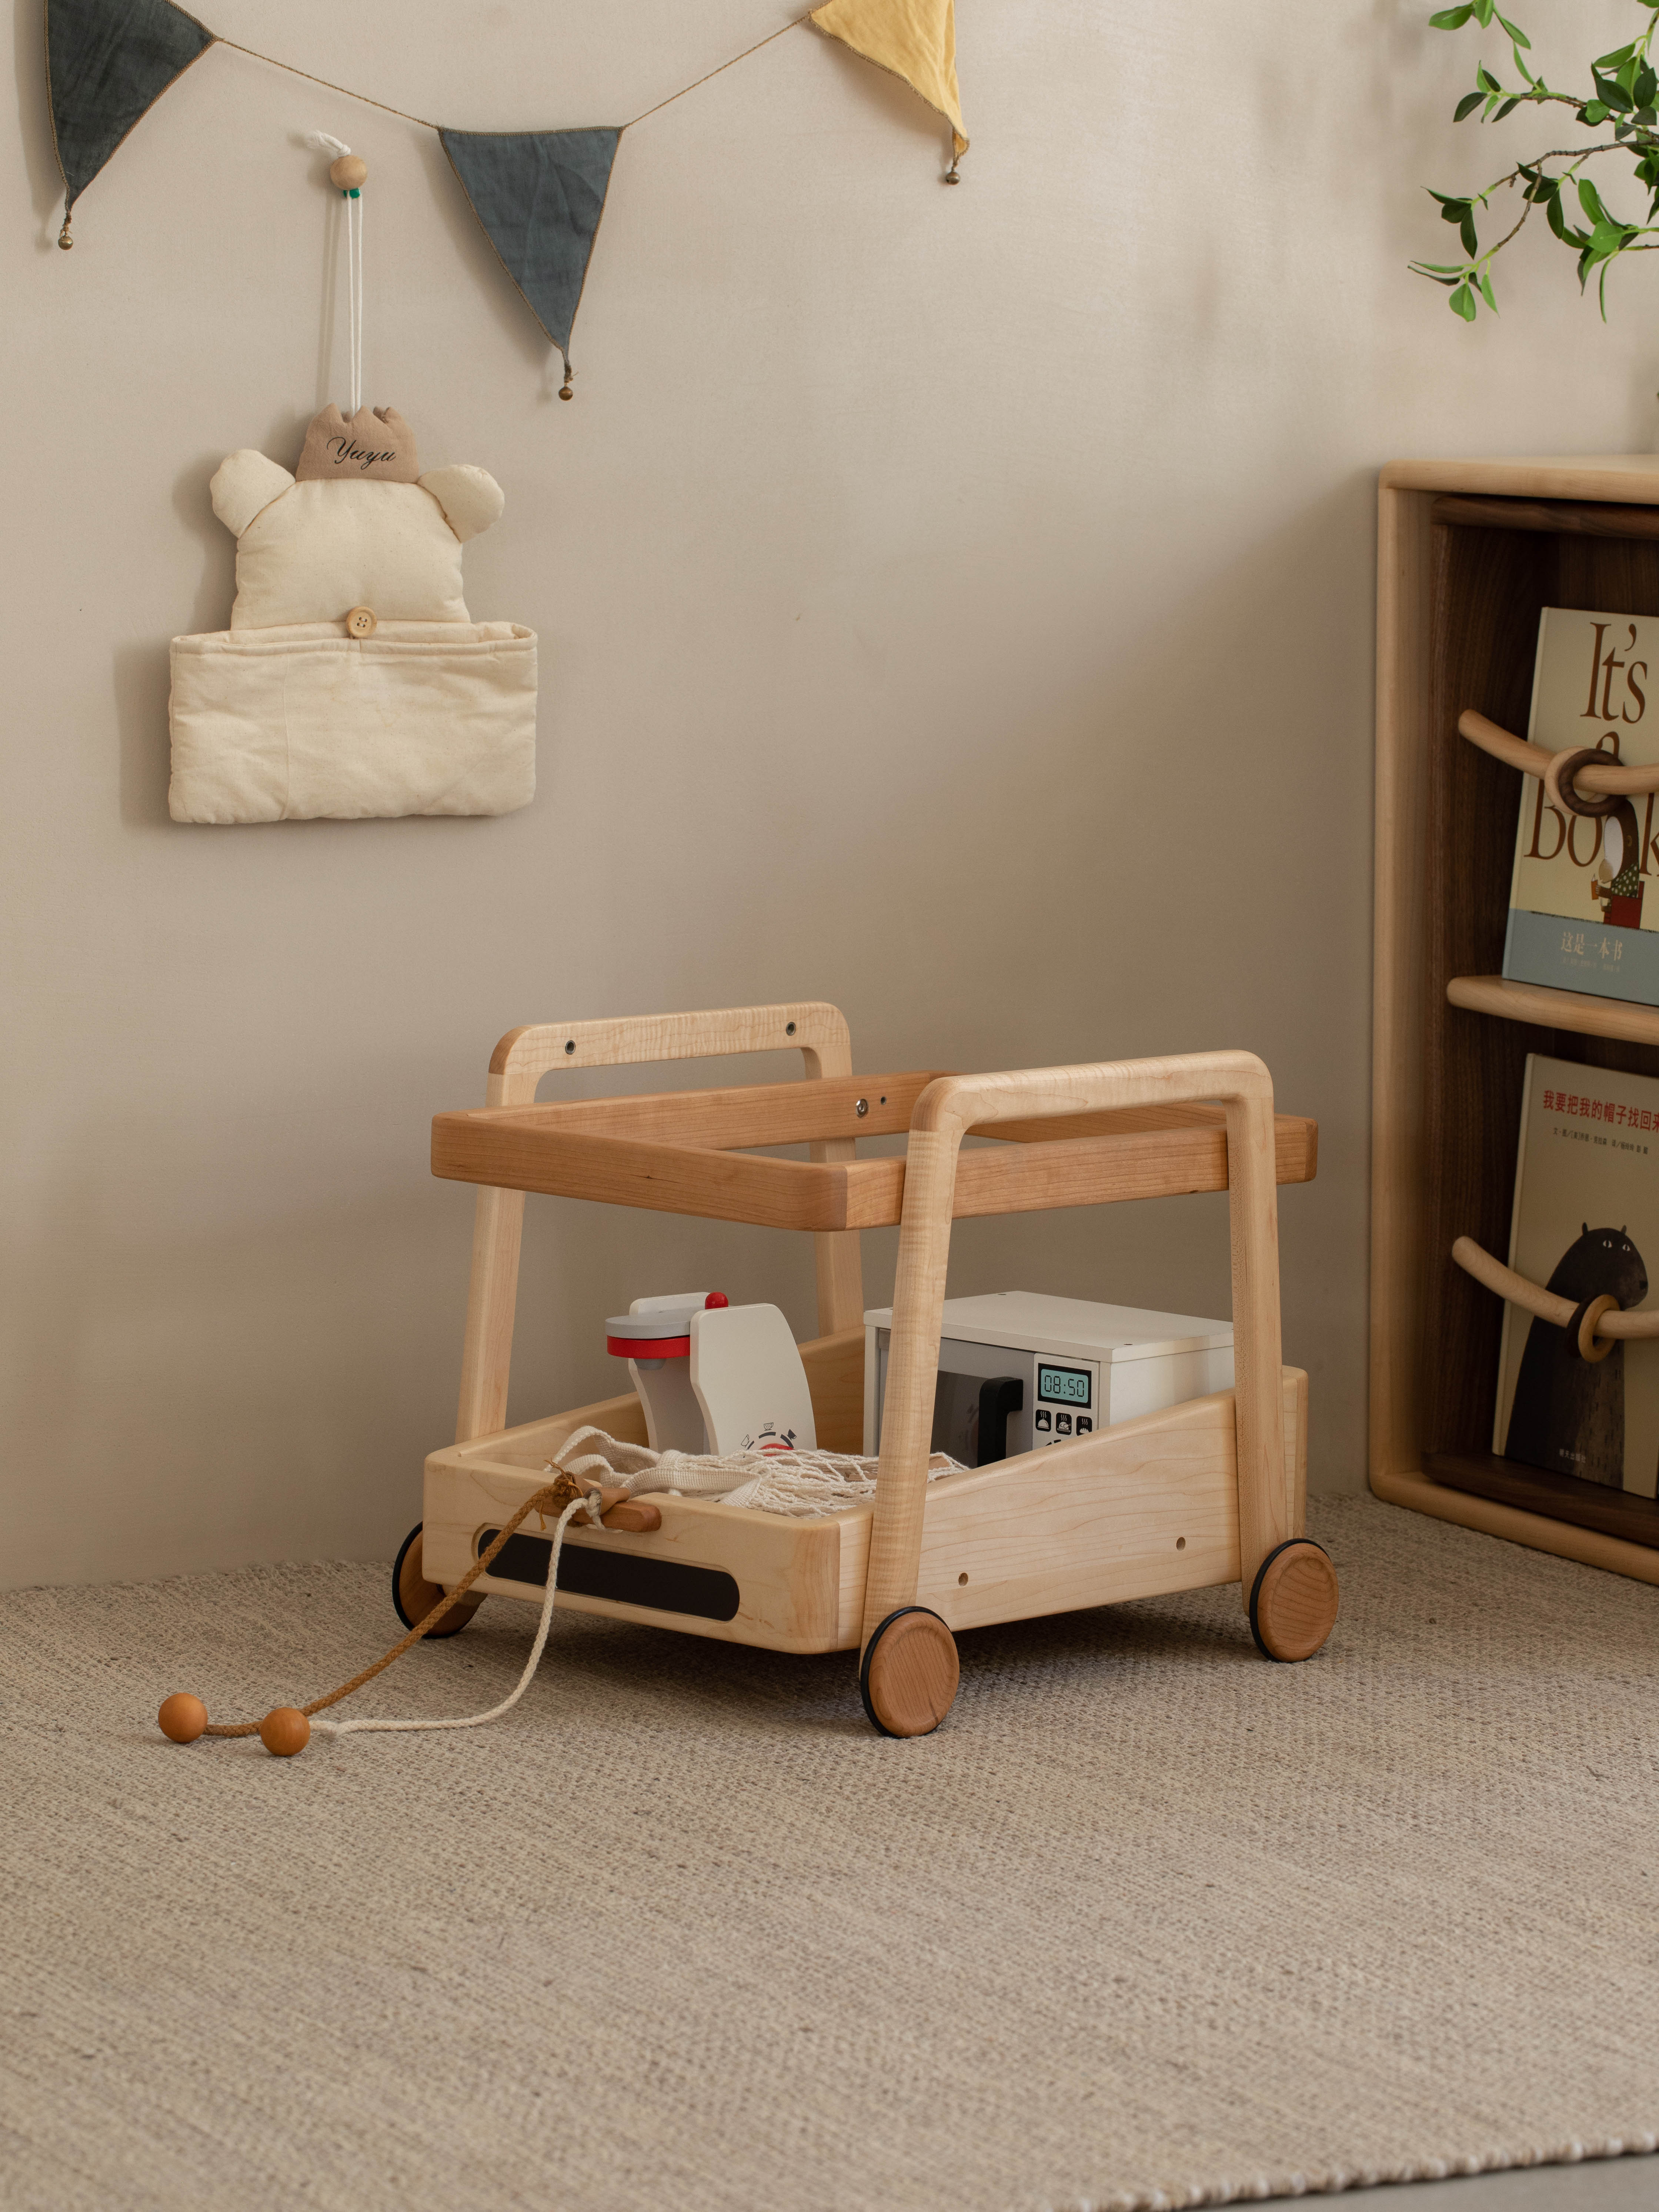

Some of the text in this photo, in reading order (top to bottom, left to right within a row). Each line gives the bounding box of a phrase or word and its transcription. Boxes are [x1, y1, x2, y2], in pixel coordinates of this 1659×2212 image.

[326, 437, 396, 470] Yuyu
[1579, 621, 1648, 724] It's
[1523, 779, 1659, 876] bok
[1560, 931, 1623, 961] 这是一本书
[1543, 1090, 1659, 1133] 我要把我的帽子找回来
[1044, 1375, 1084, 1397] 08:50
